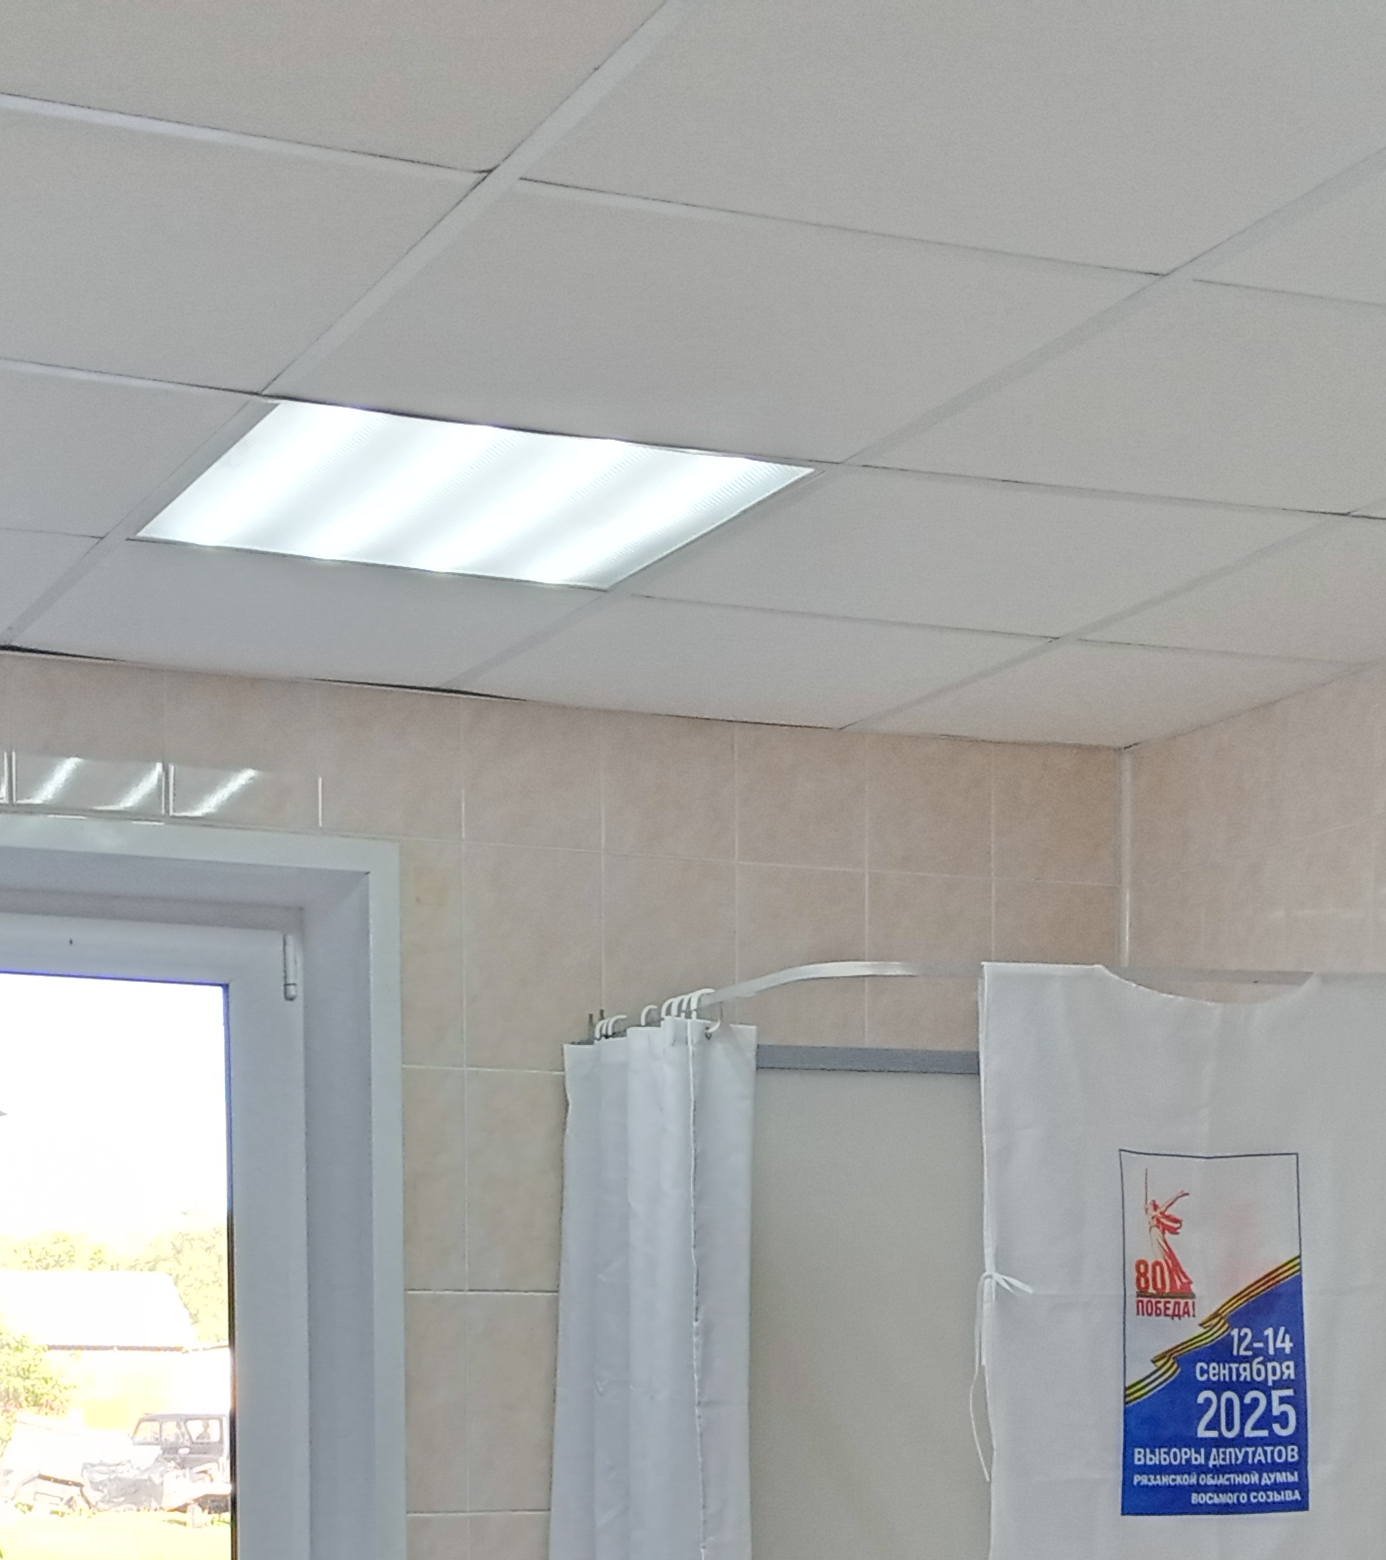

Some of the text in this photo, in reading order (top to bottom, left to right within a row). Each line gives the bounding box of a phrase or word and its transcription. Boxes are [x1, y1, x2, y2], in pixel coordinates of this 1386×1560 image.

[1135, 1258, 1167, 1294] 80
[1135, 1298, 1196, 1320] ПОБЕДА!
[1230, 1326, 1294, 1356] 12-14
[1195, 1356, 1296, 1387] сентября
[1196, 1388, 1297, 1439] 2025
[1133, 1444, 1300, 1469] ВЫБОРЫ ДЕПУТАТОВ
[1261, 1470, 1299, 1486] ДУМЫ
[1250, 1489, 1302, 1503] СОЗЫВА
